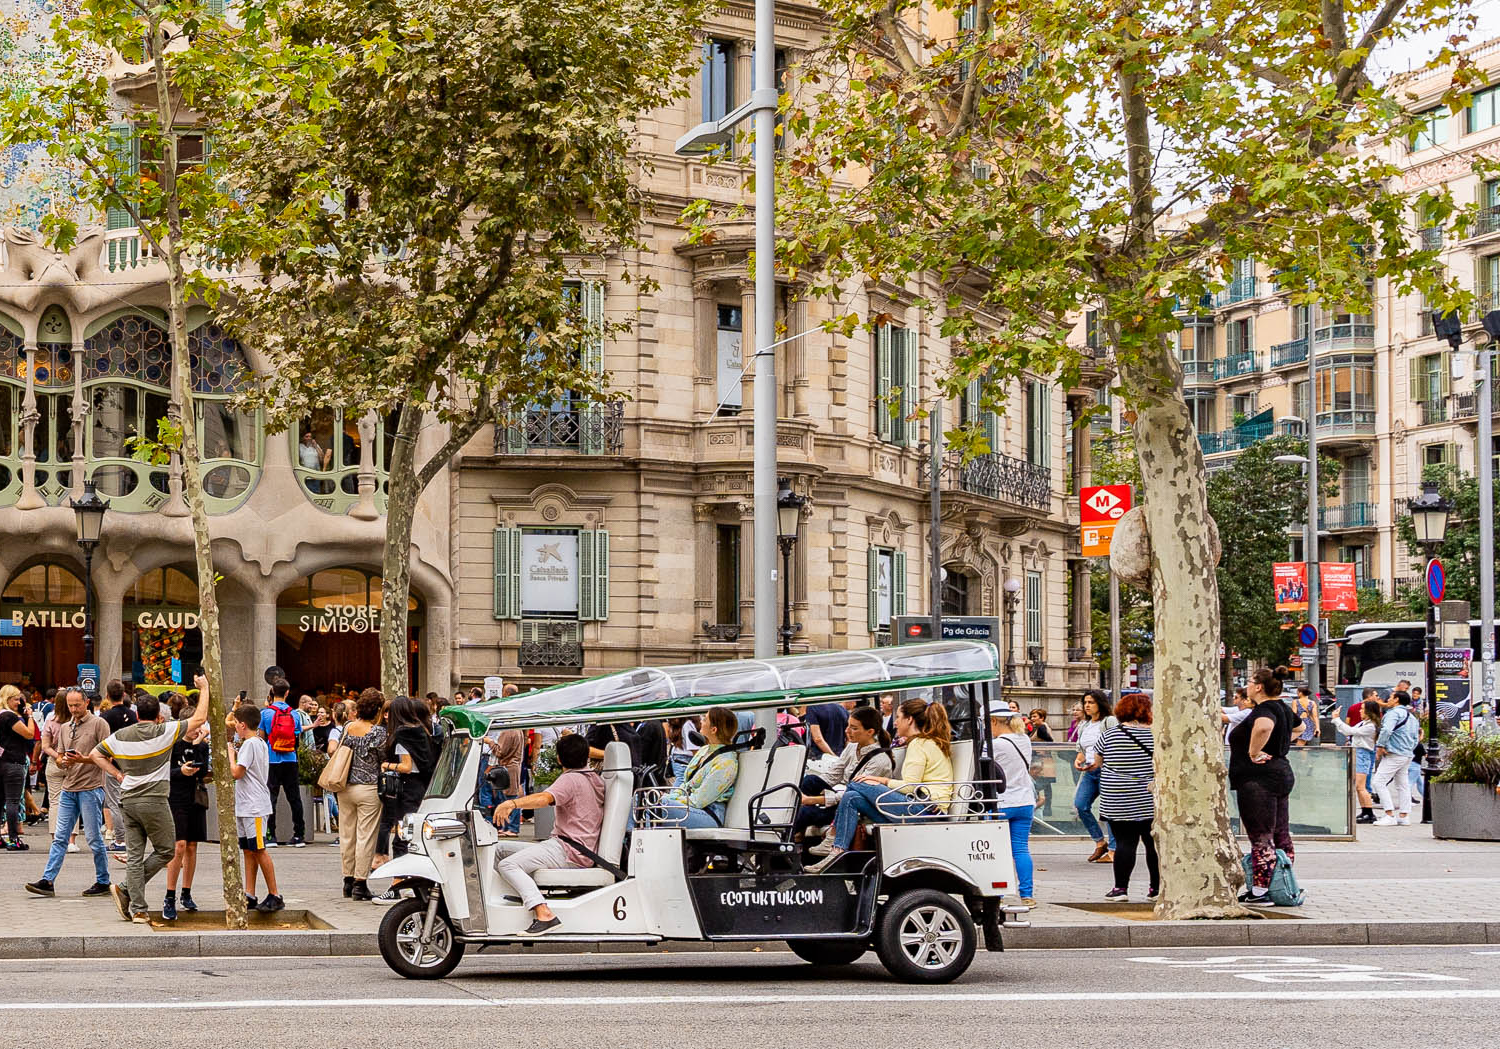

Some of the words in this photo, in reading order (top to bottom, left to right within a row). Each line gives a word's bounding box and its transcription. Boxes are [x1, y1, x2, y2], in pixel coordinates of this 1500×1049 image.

[1095, 495, 1110, 508] M
[12, 606, 86, 629] BATLLÓ
[324, 604, 379, 618] STORE
[137, 611, 200, 629] GAUD
[299, 615, 380, 633] SIMBOL
[943, 627, 954, 636] Pg
[955, 627, 964, 635] de
[965, 626, 990, 635] Gràcia
[0, 639, 23, 647] CKETS
[971, 839, 990, 852] ECO
[968, 852, 996, 862] TUKTUK
[720, 889, 824, 906] ECOTUKTUK.COM
[612, 895, 627, 921] 6
